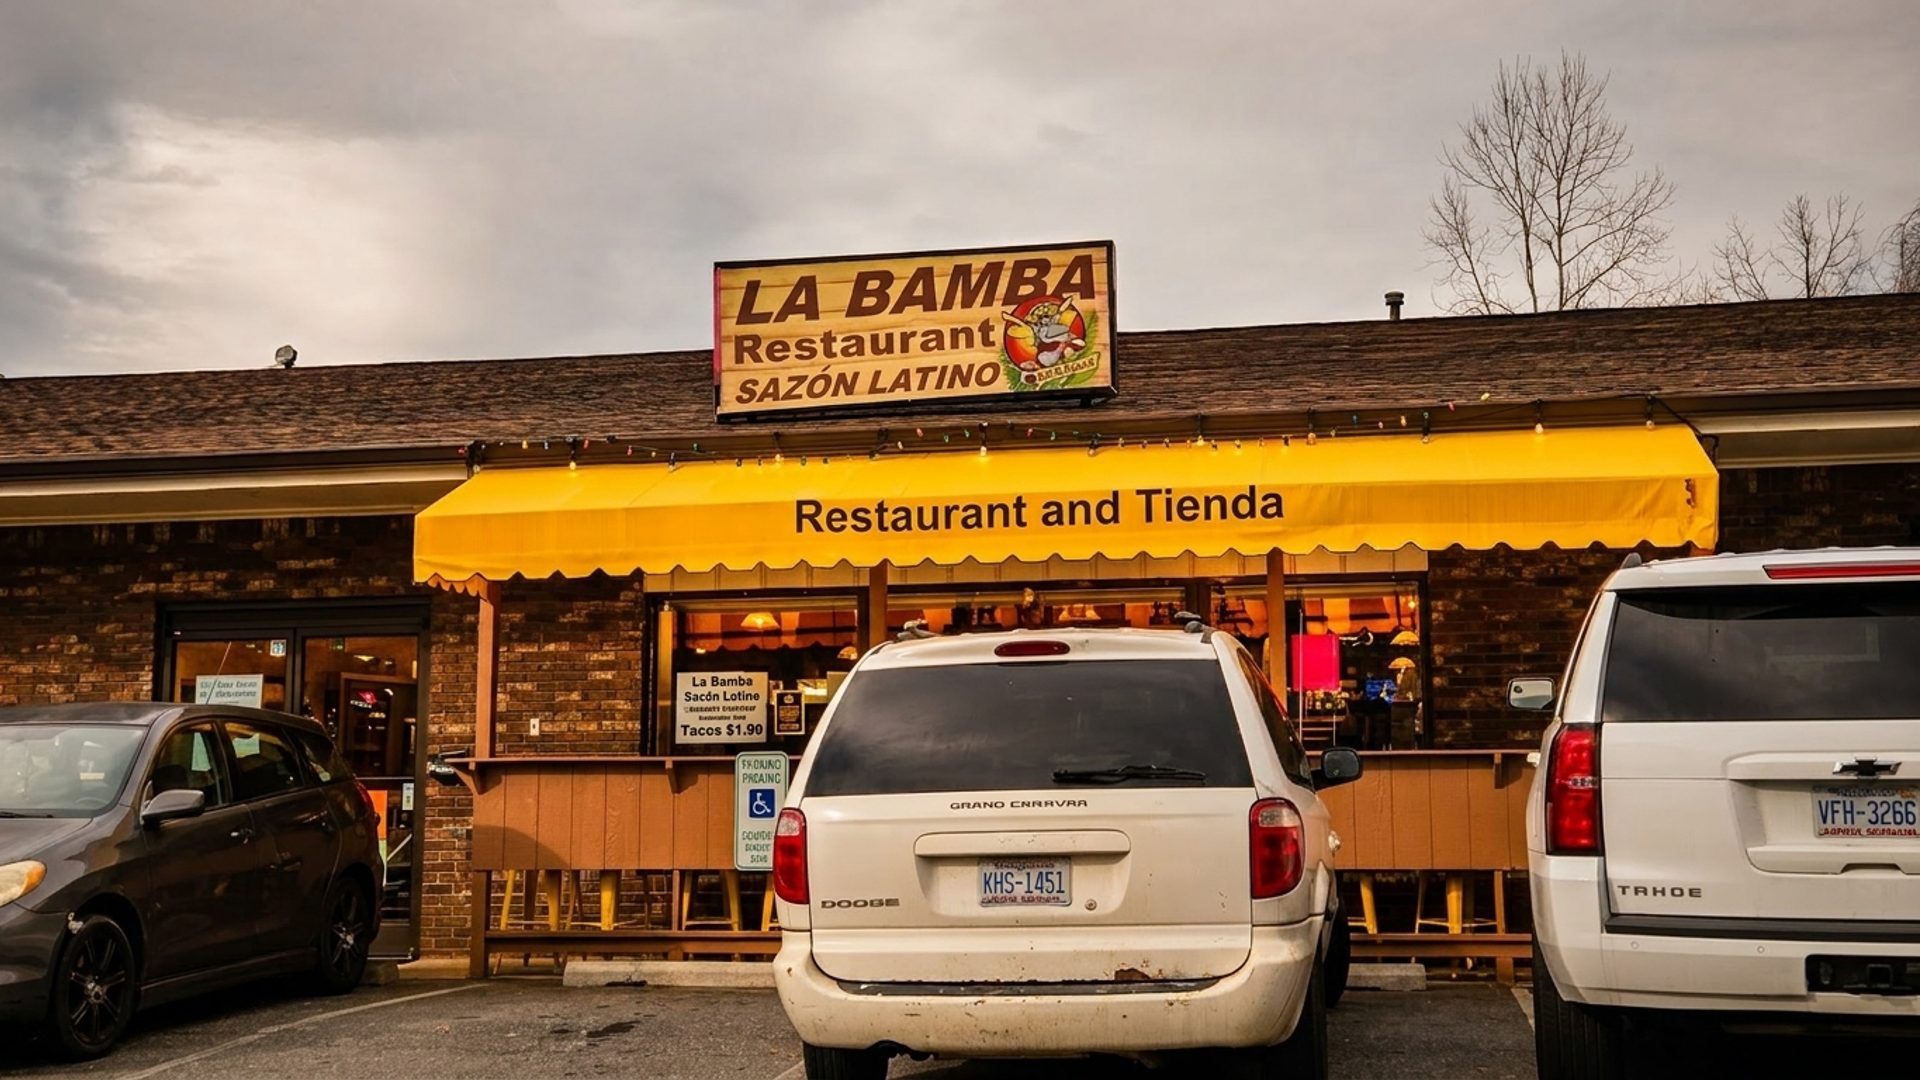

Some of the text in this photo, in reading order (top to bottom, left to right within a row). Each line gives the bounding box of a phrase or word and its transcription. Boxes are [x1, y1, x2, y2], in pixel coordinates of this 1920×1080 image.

[735, 254, 1096, 325] LA BAMBA
[734, 321, 996, 364] Restaurant
[735, 365, 860, 404] SAZÓN
[868, 361, 1001, 395] LATINO
[795, 485, 1285, 534] Restaurant and Tienda
[692, 676, 753, 687] La Bamba
[680, 723, 764, 736] Tacos $1.90
[1818, 800, 1917, 826] VFH-3266
[983, 871, 1065, 894] KHS-1451
[1617, 885, 1702, 898] TAHOE
